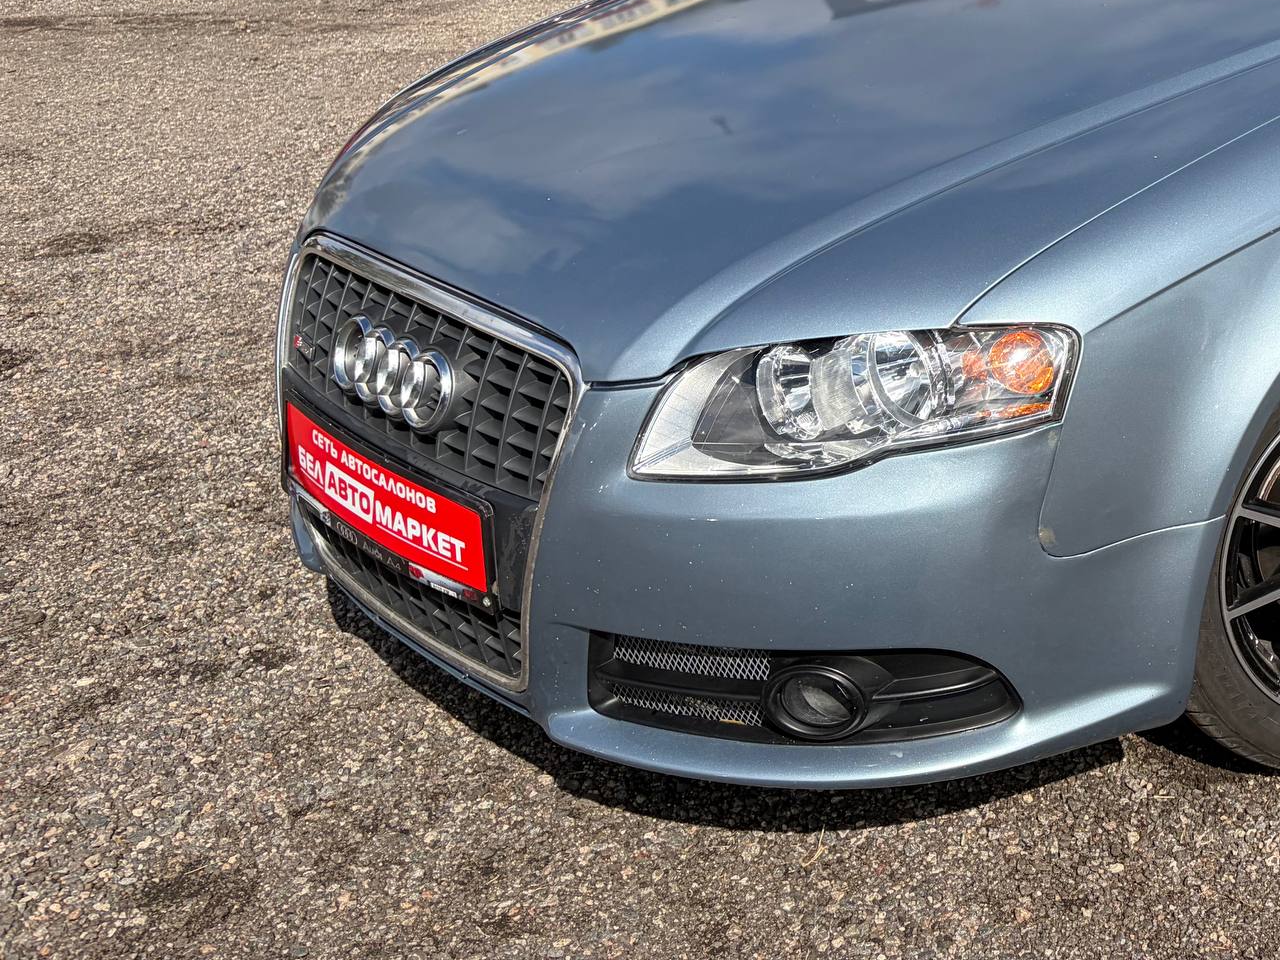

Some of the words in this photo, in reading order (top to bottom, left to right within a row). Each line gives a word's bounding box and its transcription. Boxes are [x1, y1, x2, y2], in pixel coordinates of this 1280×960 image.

[298, 445, 323, 485] БЕЛ
[328, 470, 371, 516] АВТО
[375, 500, 466, 563] МАРКЕТ
[312, 429, 338, 458] СЕТЬ
[341, 452, 437, 514] АВТОСАЛОНОВ
[362, 542, 383, 561] Audi
